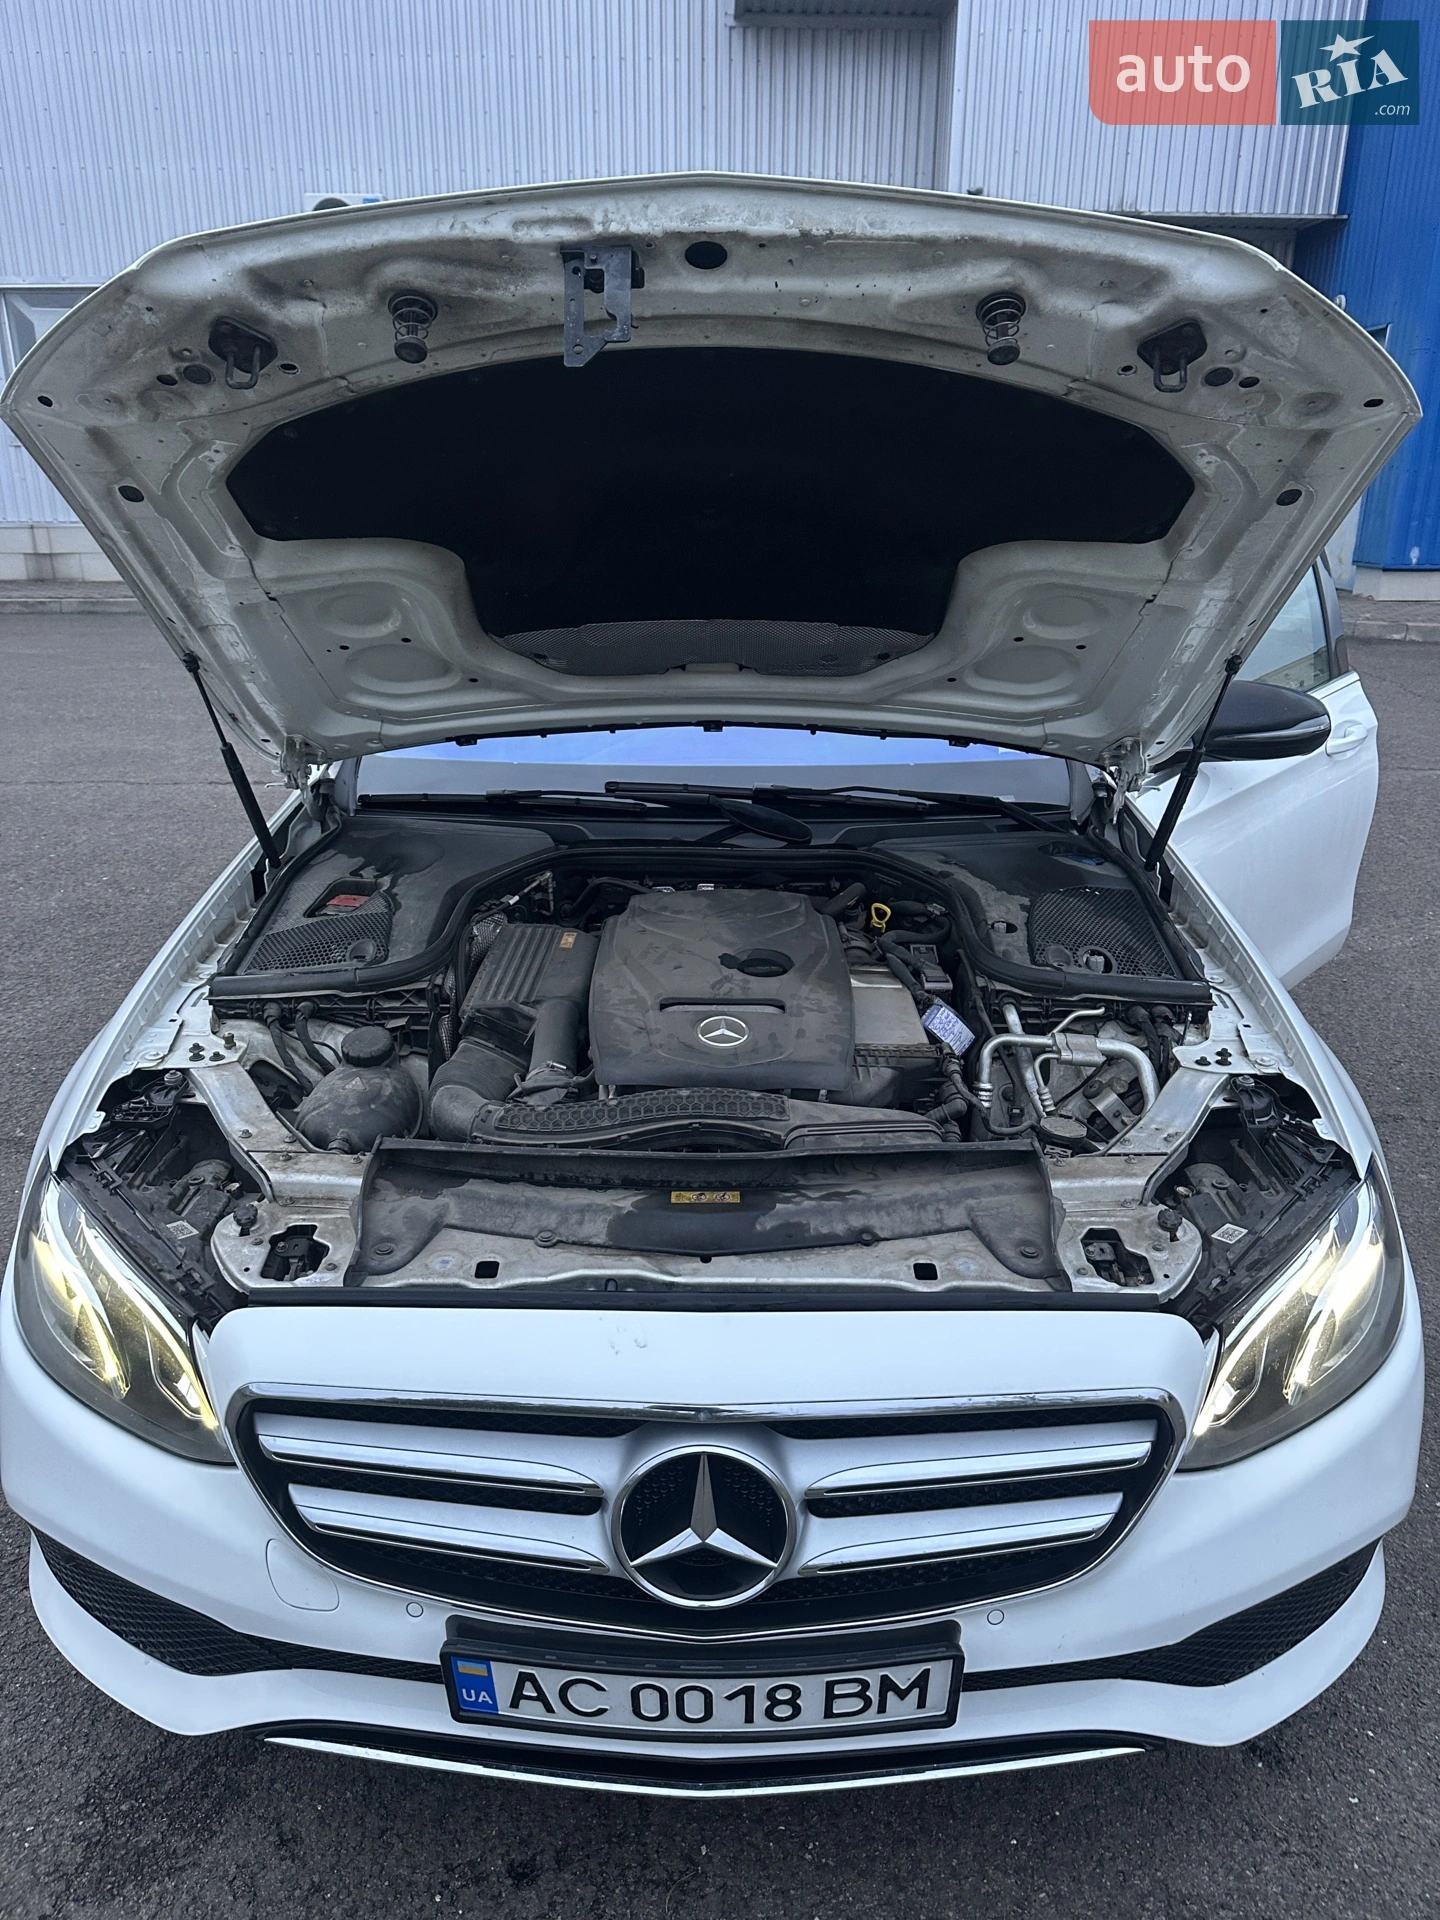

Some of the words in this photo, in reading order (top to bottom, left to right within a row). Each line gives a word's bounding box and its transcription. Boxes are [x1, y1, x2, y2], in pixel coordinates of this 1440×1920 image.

[461, 1688, 494, 1705] UA
[508, 1669, 612, 1718] AC
[630, 1682, 802, 1725] 0018
[823, 1667, 931, 1720] BM
